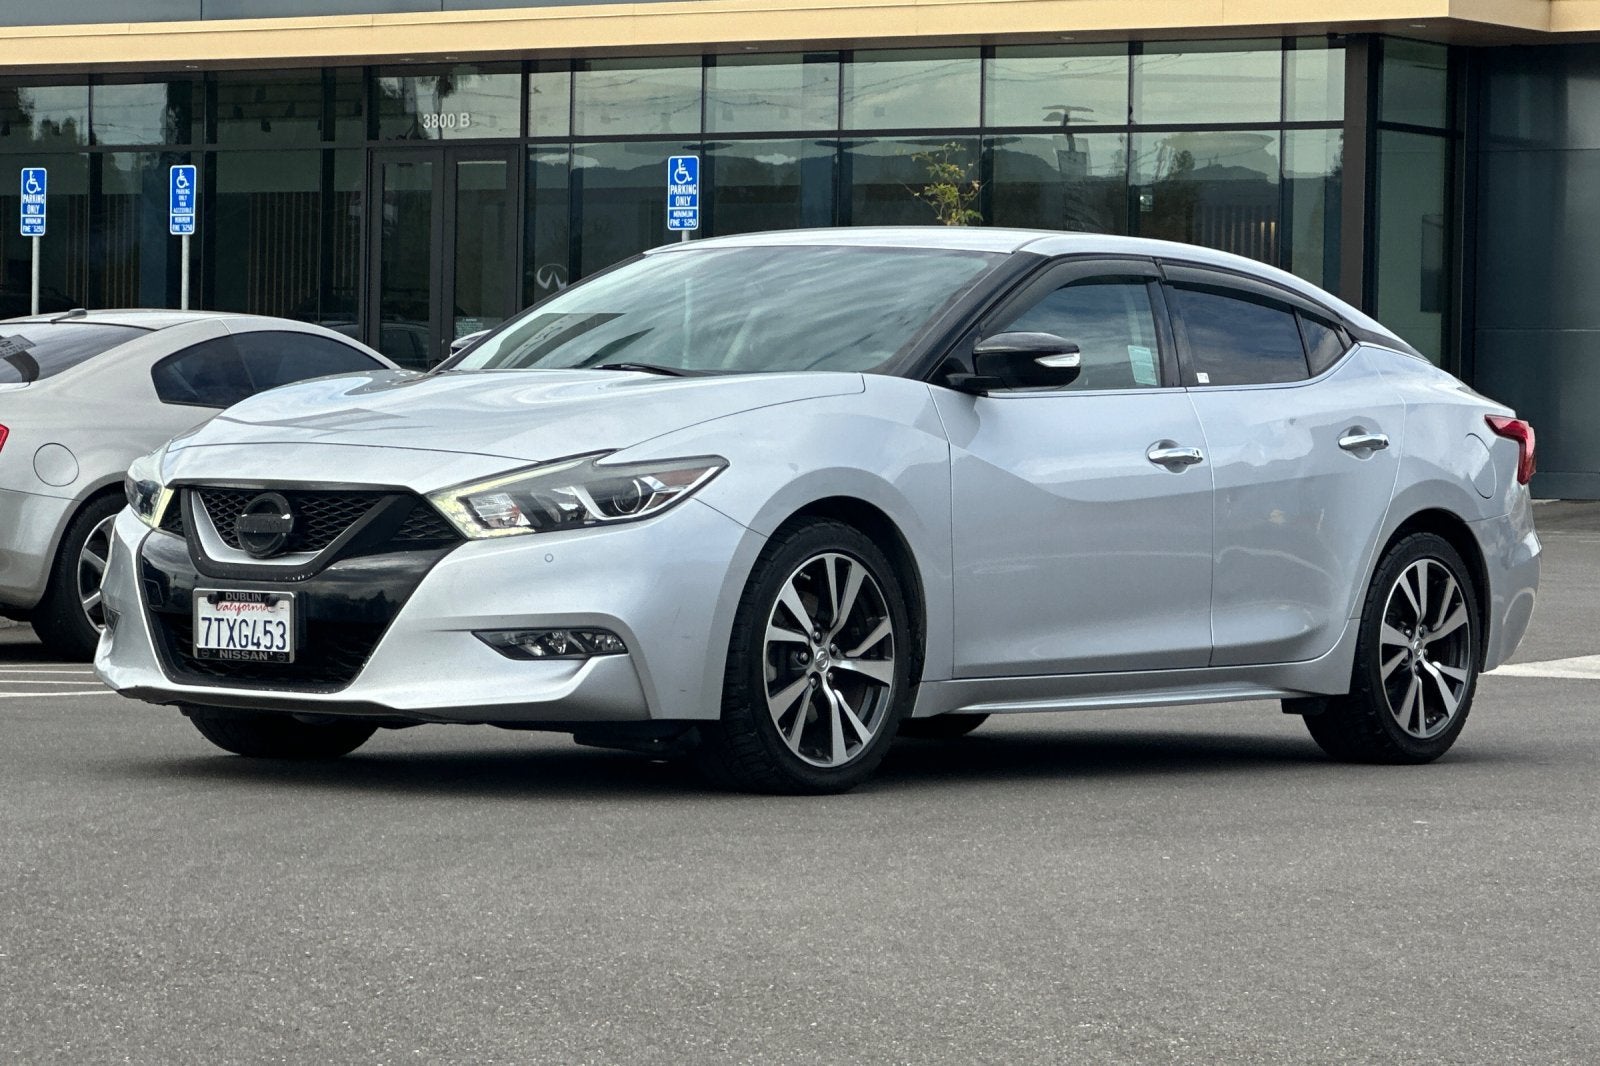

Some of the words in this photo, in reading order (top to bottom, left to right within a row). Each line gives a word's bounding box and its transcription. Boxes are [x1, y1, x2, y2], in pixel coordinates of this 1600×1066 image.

[423, 113, 456, 129] 3800
[460, 112, 470, 127] B
[670, 184, 697, 195] PARKING
[22, 193, 45, 204] PARKING
[675, 196, 691, 206] ONLY
[26, 204, 40, 214] ONLY
[670, 218, 680, 227] FINE
[225, 592, 262, 602] DUBLIN
[215, 601, 271, 616] California
[201, 616, 287, 651] 7TXG453
[219, 650, 268, 661] NISSAN
